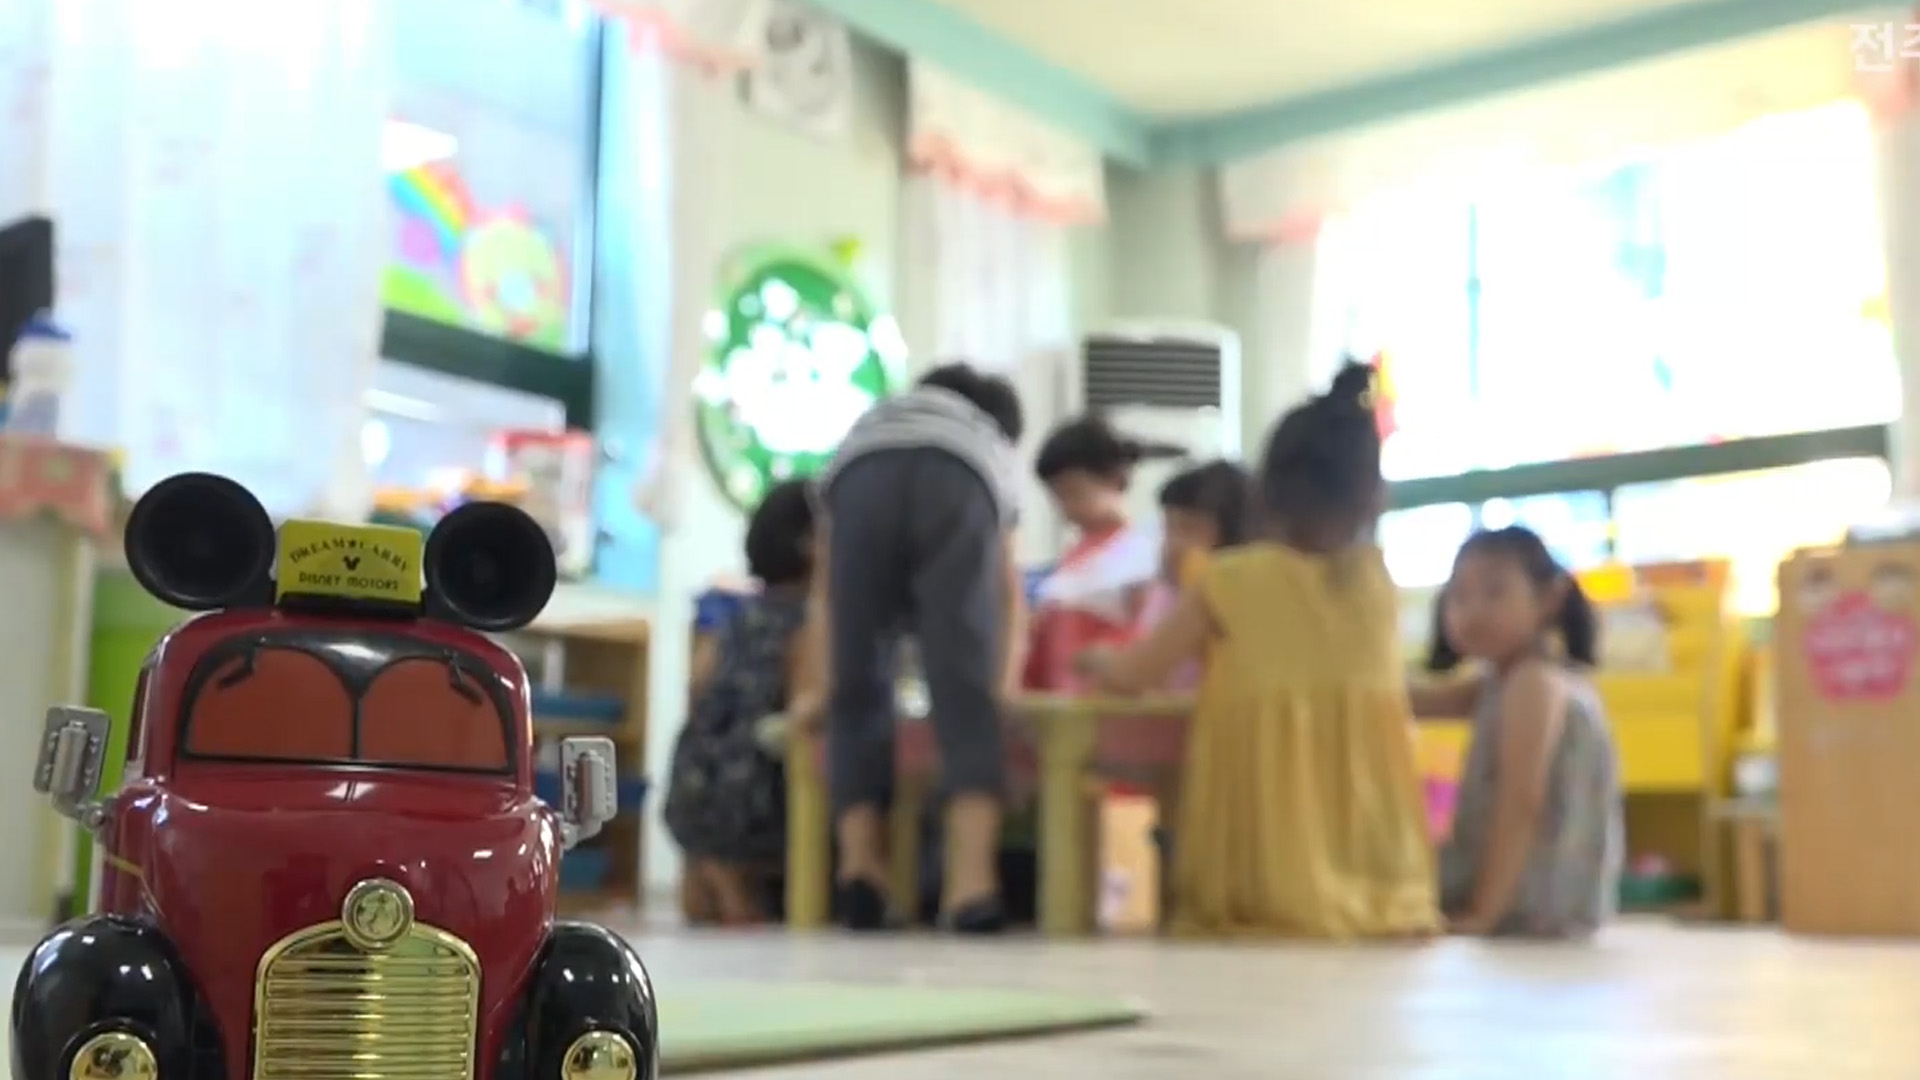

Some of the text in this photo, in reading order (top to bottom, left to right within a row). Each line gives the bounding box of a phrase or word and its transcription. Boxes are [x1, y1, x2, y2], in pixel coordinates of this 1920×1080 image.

[290, 538, 344, 563] DREAM
[298, 571, 399, 591] DISNEY MOTORS
